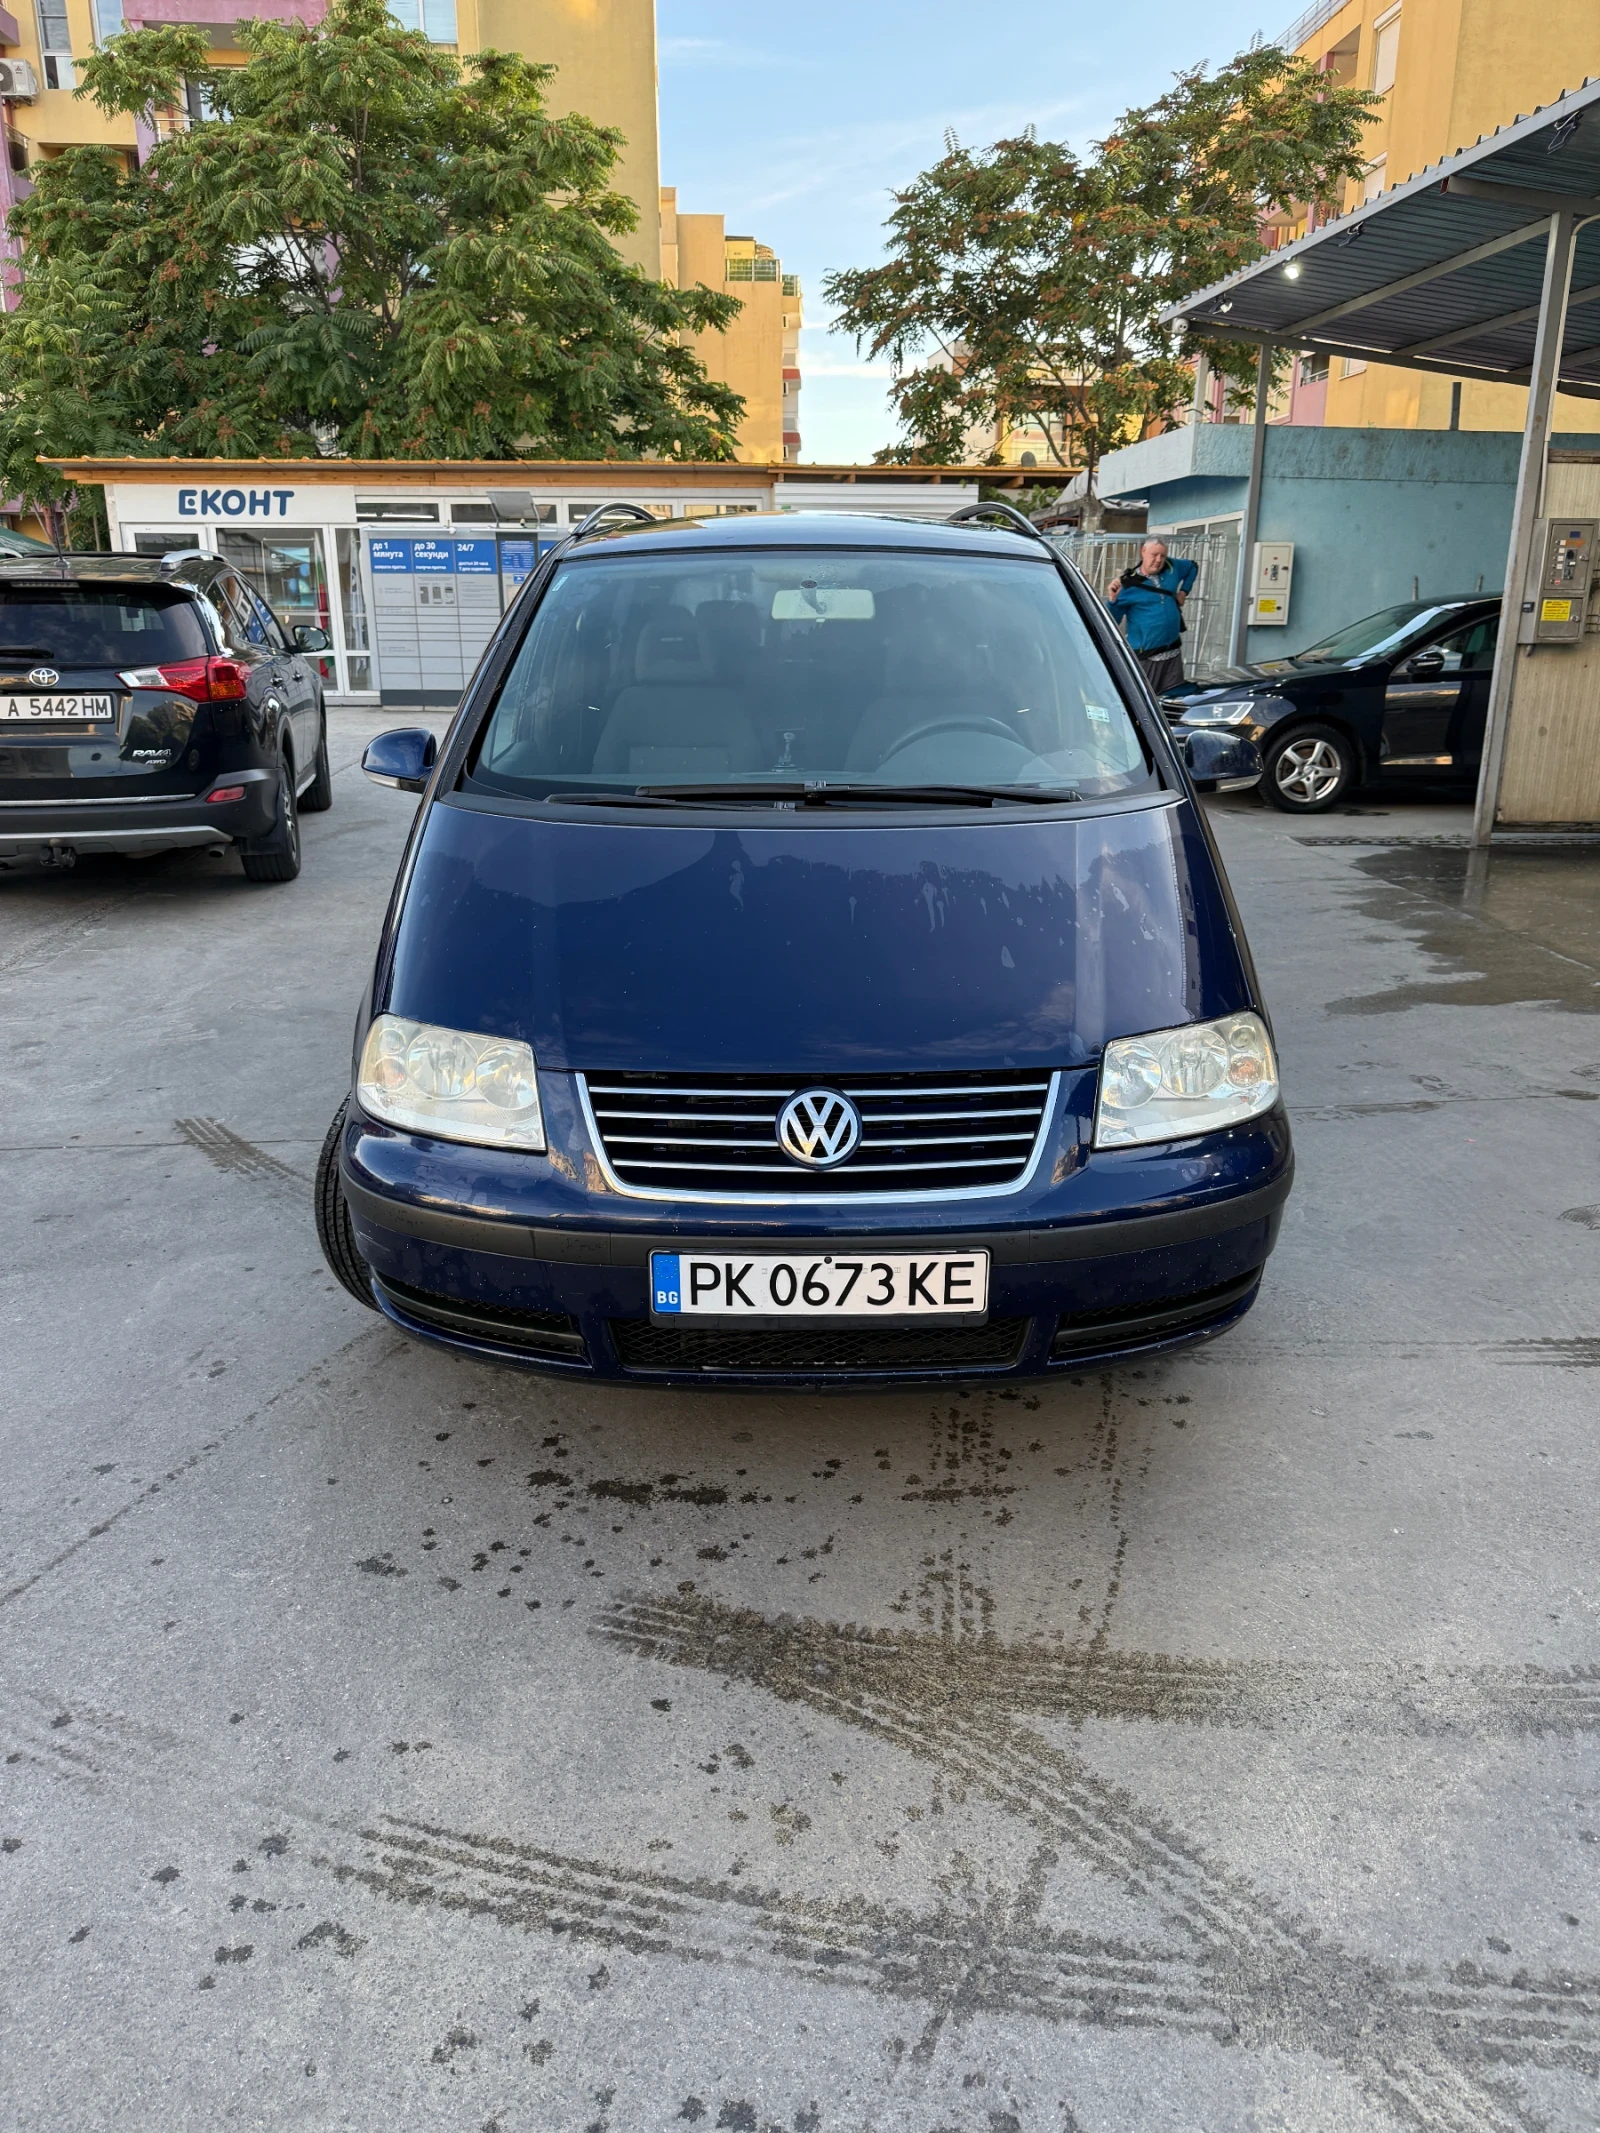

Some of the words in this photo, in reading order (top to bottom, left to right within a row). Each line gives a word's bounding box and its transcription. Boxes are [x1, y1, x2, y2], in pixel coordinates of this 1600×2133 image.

[179, 489, 295, 516] ЕКОНТ
[372, 543, 383, 551] до
[414, 543, 425, 551] до
[457, 544, 474, 552] 24/7
[373, 551, 404, 559] минута
[414, 551, 449, 559] секунди
[8, 698, 19, 717] A
[30, 698, 78, 716] 5442
[82, 698, 108, 716] HM
[132, 749, 172, 757] RAV4
[690, 1262, 756, 1307] PK
[769, 1262, 895, 1307] 0673
[908, 1261, 975, 1307] KE
[657, 1291, 678, 1304] BG
